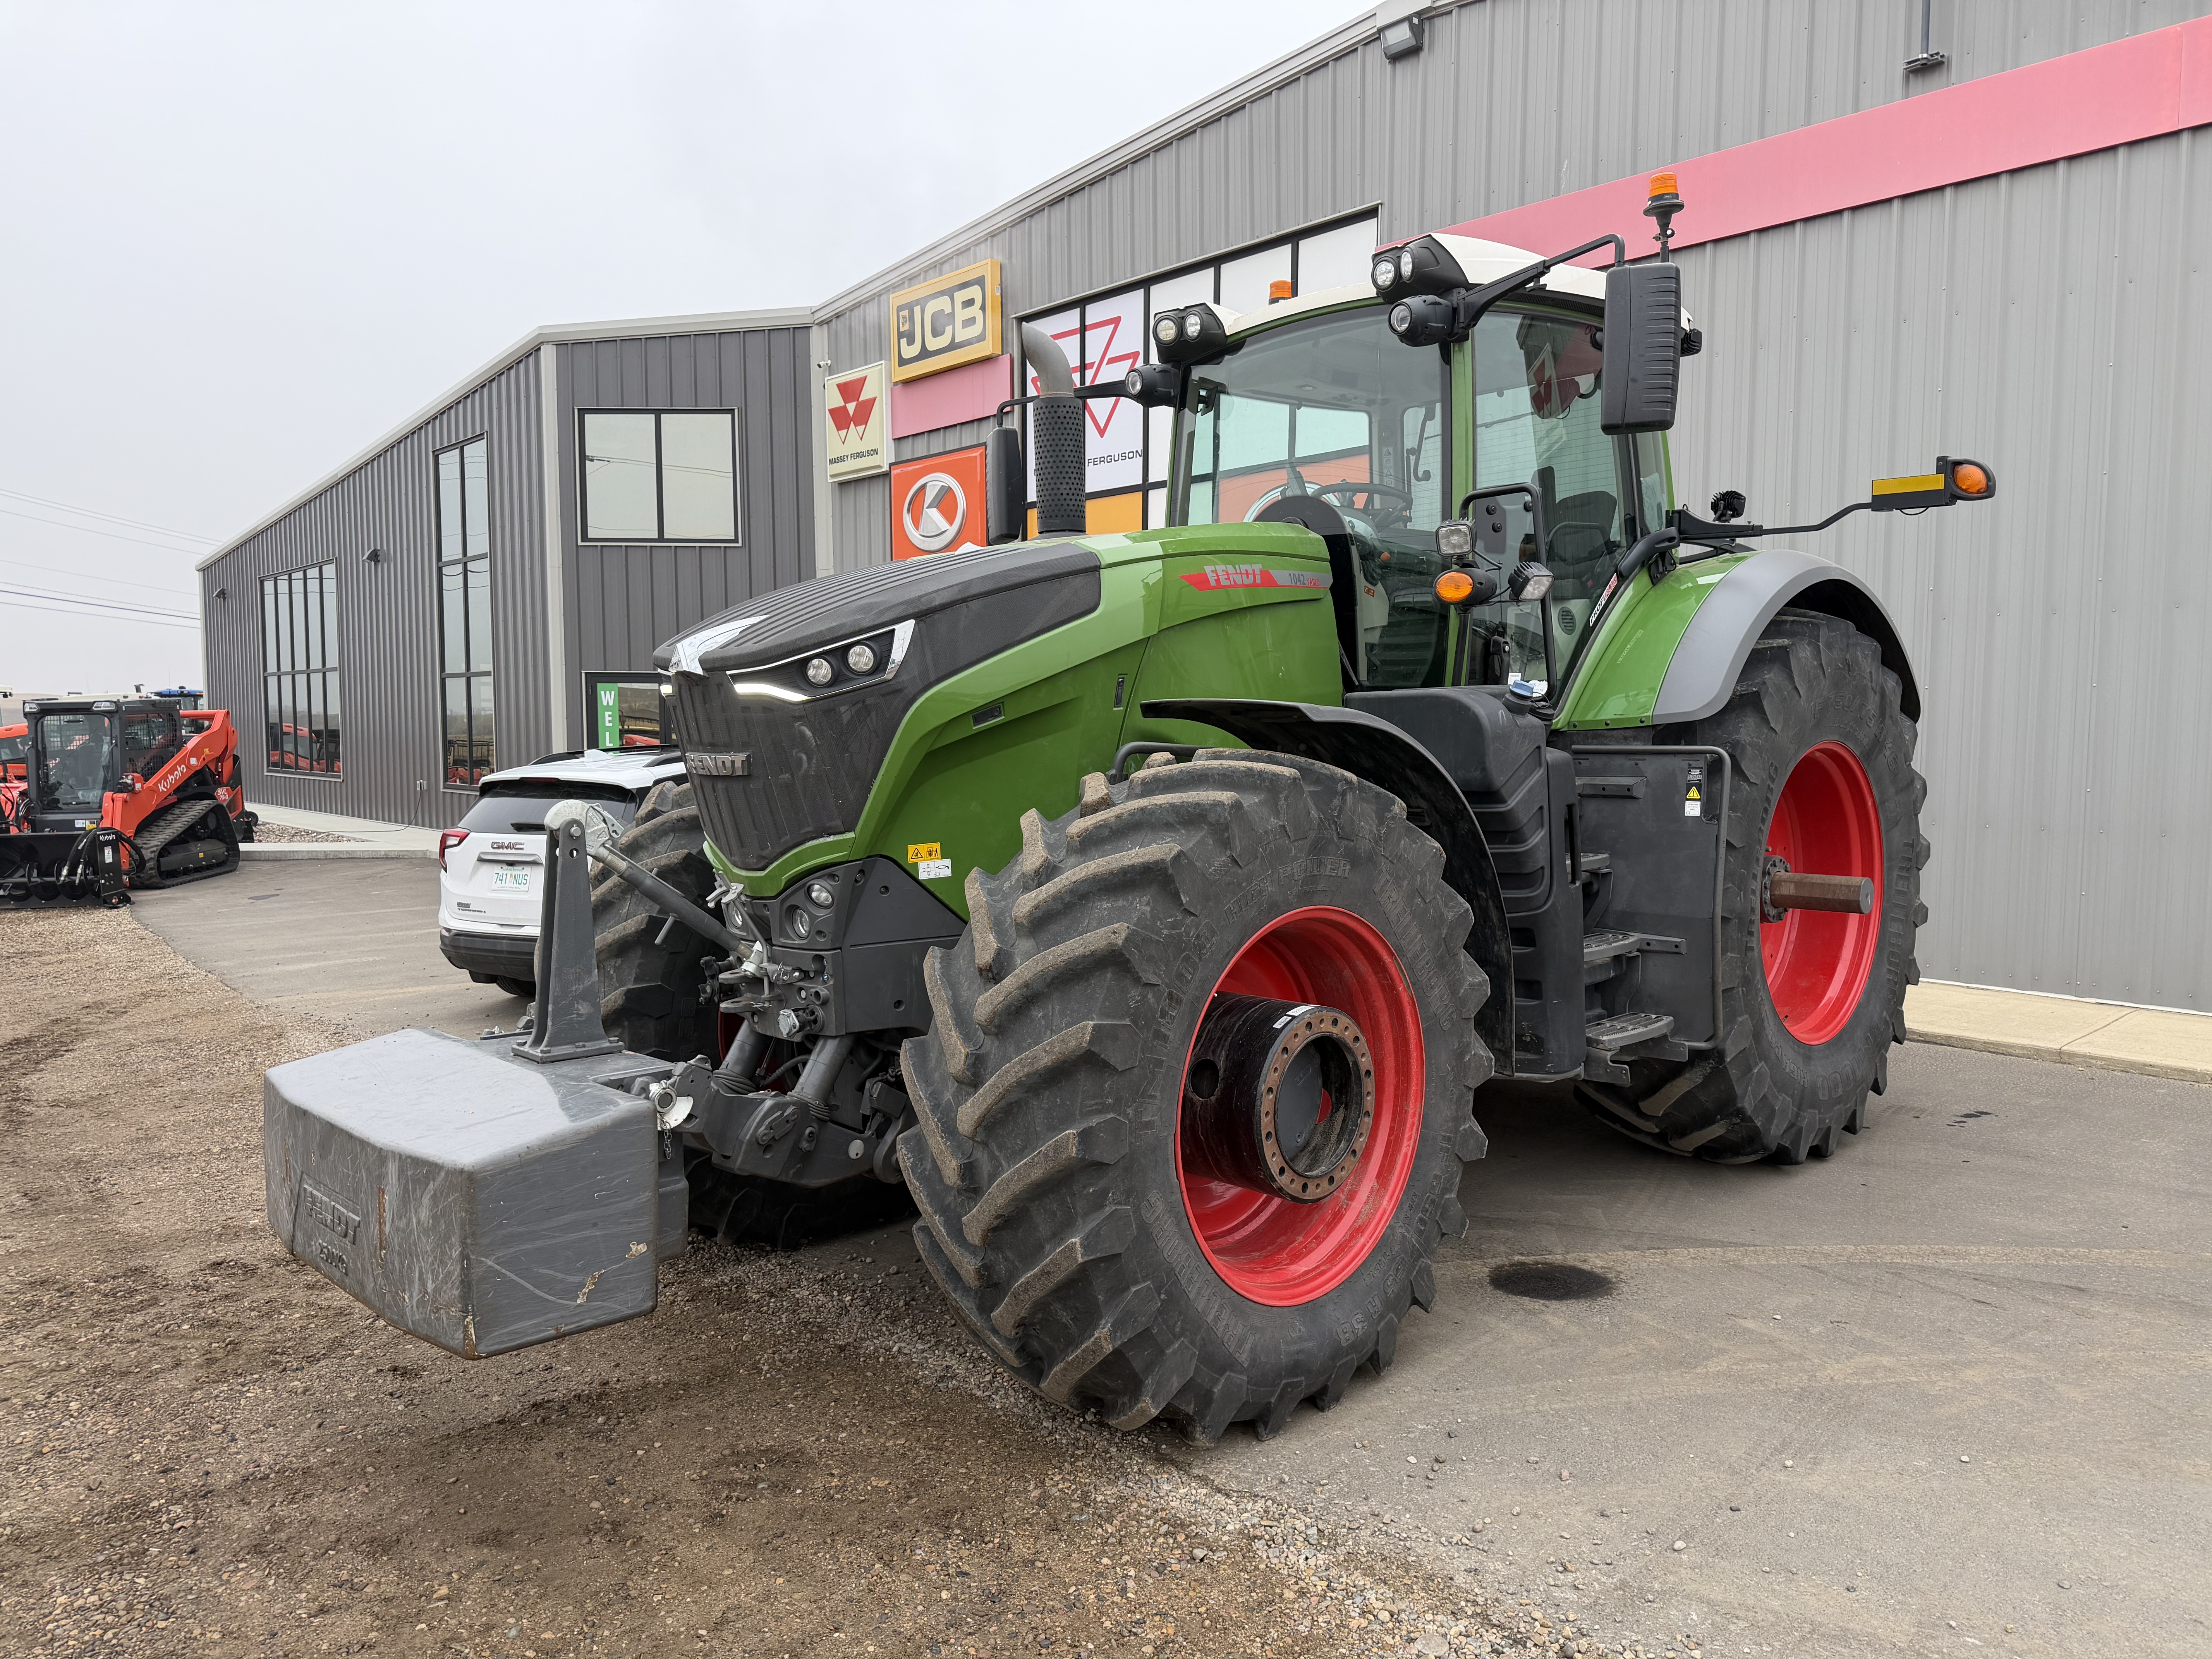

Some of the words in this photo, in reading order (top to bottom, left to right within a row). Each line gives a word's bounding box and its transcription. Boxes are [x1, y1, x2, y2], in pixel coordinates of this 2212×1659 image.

[900, 285, 984, 359] JCB
[829, 454, 849, 465] MASSEY
[850, 448, 878, 460] FERGUSON
[1087, 449, 1143, 467] FERGUSON
[1204, 564, 1262, 586] FENDT
[1288, 573, 1306, 585] 1042
[158, 764, 186, 792] Kubota
[685, 754, 747, 776] FENDT
[491, 841, 525, 850] GMC
[495, 872, 508, 884] 741
[513, 873, 528, 885] NUS
[1224, 871, 1274, 927] HIGH
[1277, 856, 1351, 887] POWER
[1886, 838, 1915, 1006] TRELLEBORG
[1372, 862, 1457, 1032] TRELLEBORG
[1782, 1051, 1808, 1088] HIGH
[303, 1184, 362, 1245] FENDT
[1140, 1190, 1256, 1369] TRELLEBORG
[1336, 1310, 1368, 1346] 38
